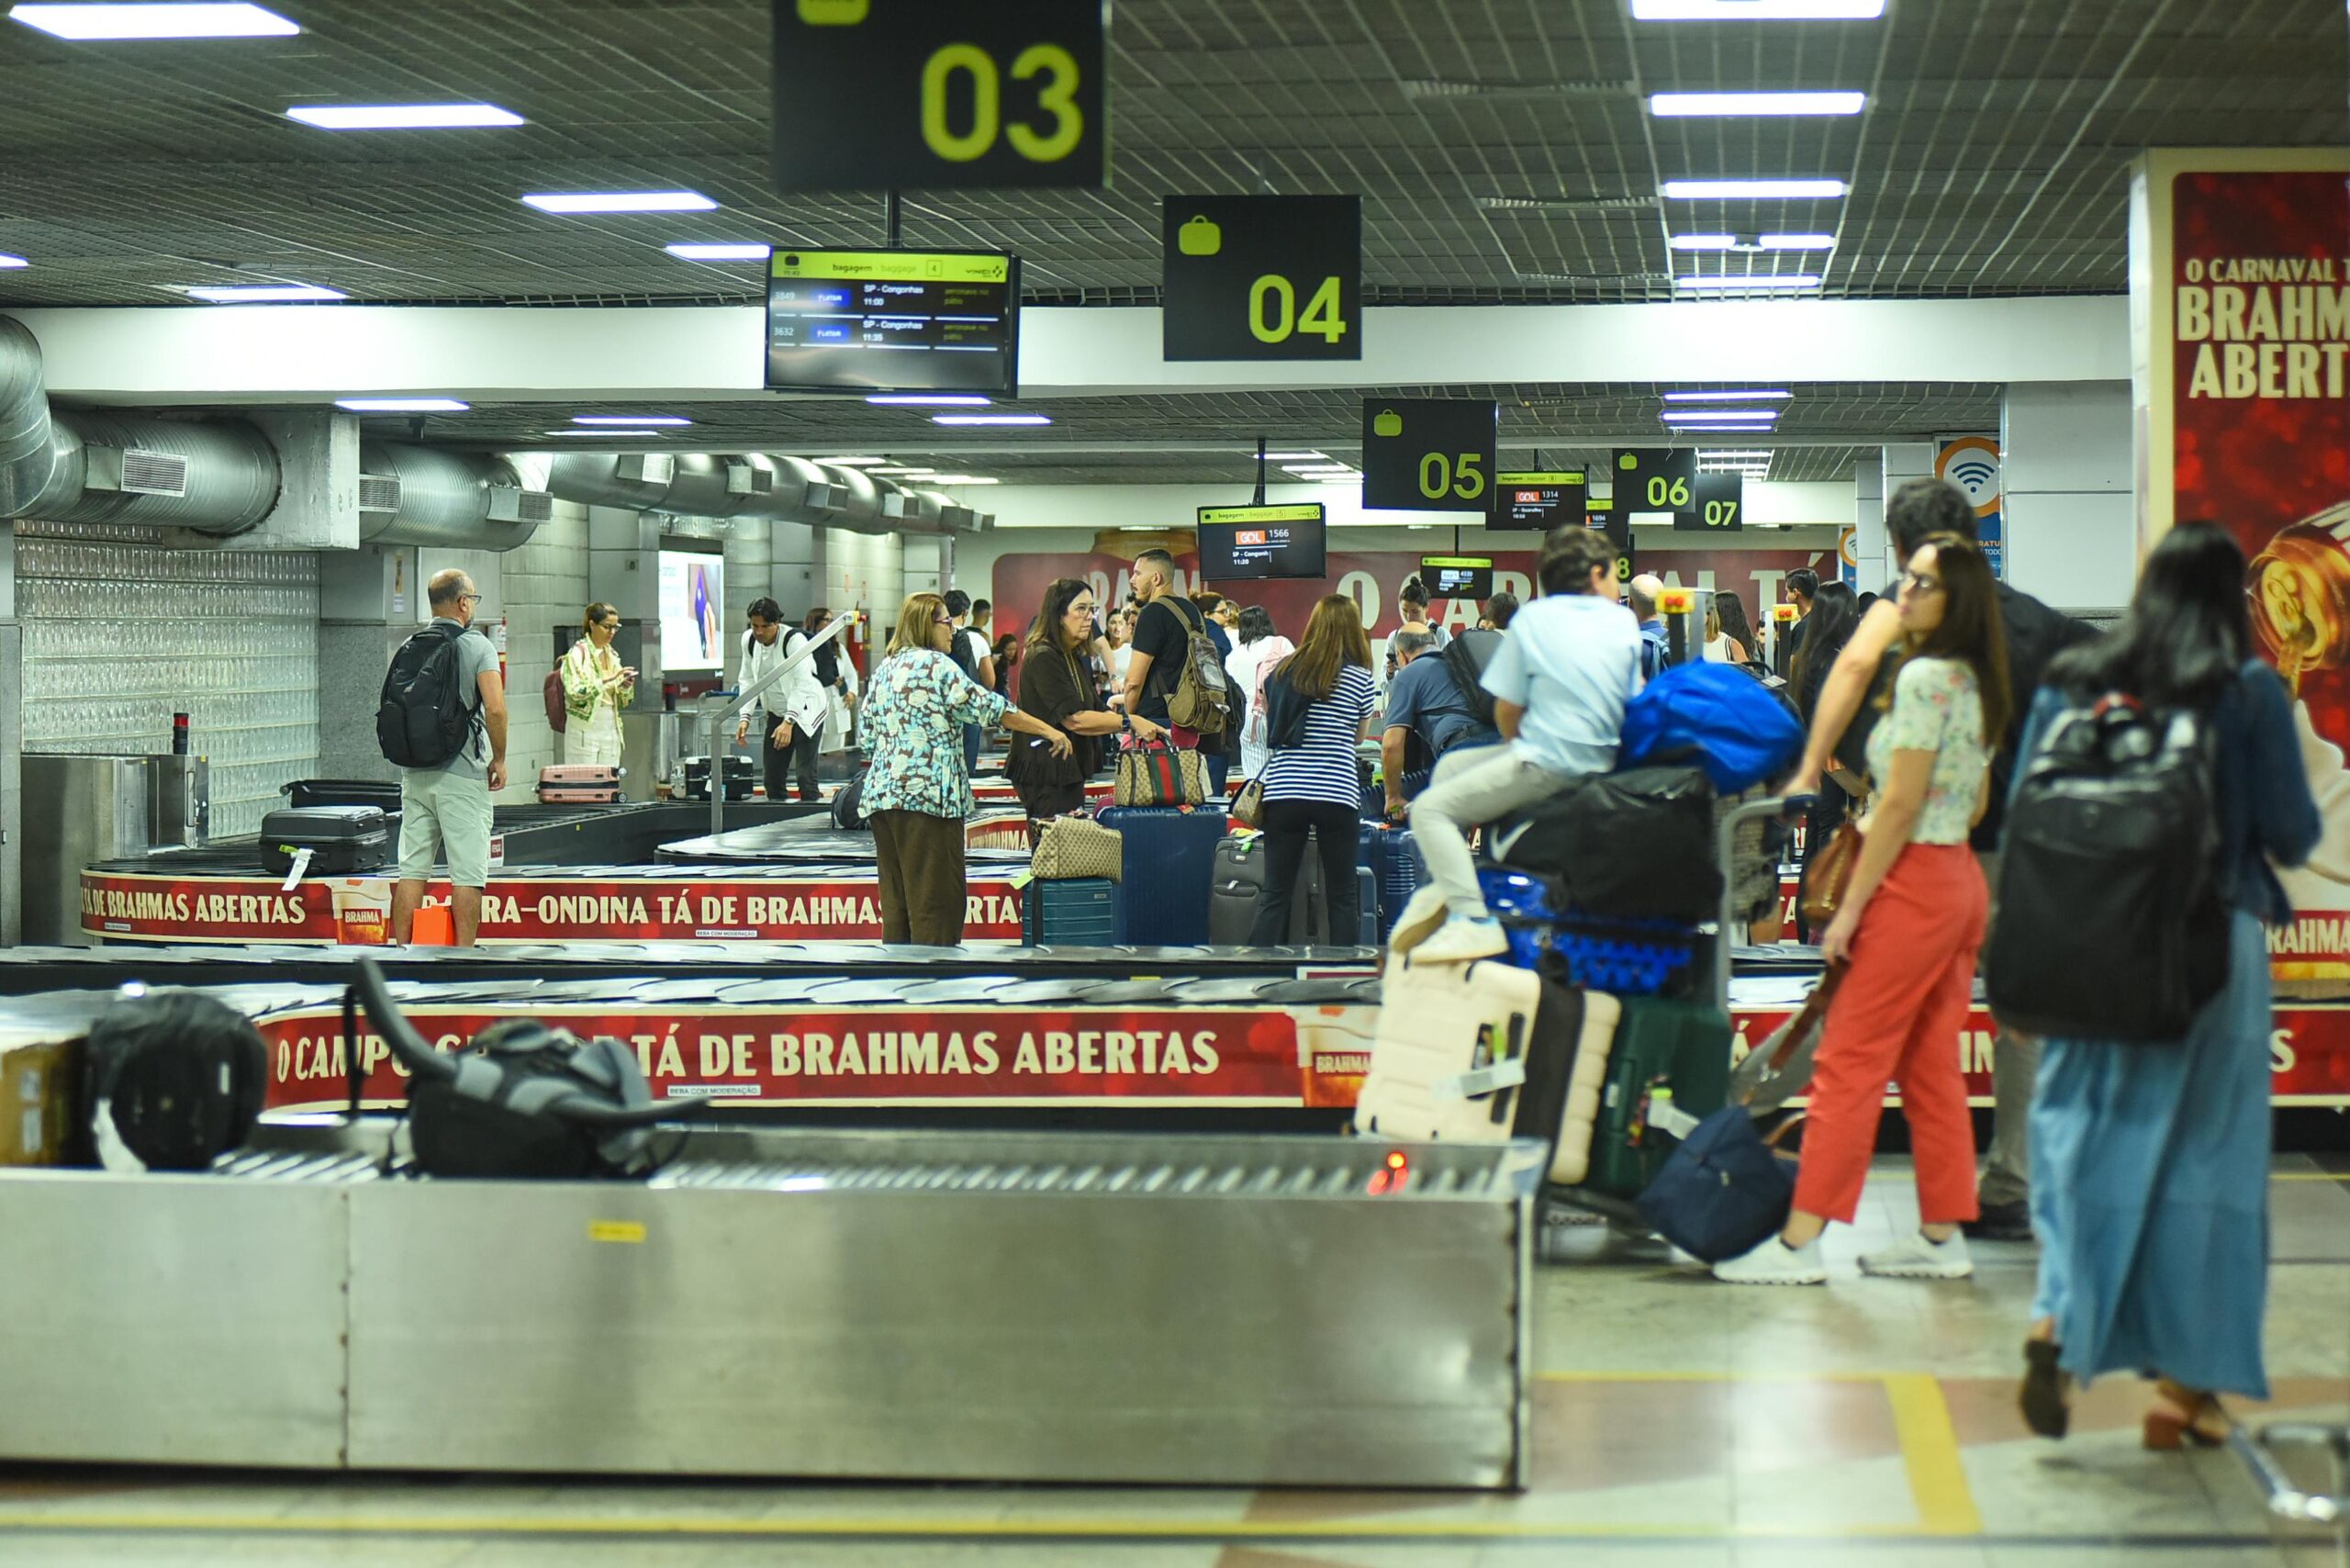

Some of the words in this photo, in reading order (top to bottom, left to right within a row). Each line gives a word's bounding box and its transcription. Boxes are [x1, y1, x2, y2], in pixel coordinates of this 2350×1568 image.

[921, 42, 1083, 162] 03
[2186, 258, 2204, 283] O
[2209, 258, 2335, 283] CARNAVAL
[774, 292, 795, 301] 3849
[864, 285, 876, 293] SP
[881, 285, 924, 295] Congonhas
[1249, 274, 1347, 343] 04
[774, 328, 794, 336] 3632
[863, 320, 875, 329] SP
[880, 320, 923, 330] Congonhas
[2188, 343, 2350, 398] ABERT
[1419, 453, 1484, 498] 05
[1647, 476, 1689, 507] 06
[1705, 500, 1737, 526] 07
[1240, 532, 1261, 543] GOL
[1269, 529, 1290, 538] 1566
[1617, 557, 1630, 579] 8
[93, 889, 106, 917] DE
[107, 890, 190, 922] BRAHMAS
[195, 893, 306, 924] ABERTAS
[344, 911, 380, 924] BRAHMA
[656, 888, 688, 924] TÁ
[700, 896, 738, 924] DE
[747, 895, 883, 925] BRAHMA
[2265, 919, 2350, 955] RAHMA
[277, 1038, 291, 1083] O
[631, 1023, 686, 1077] TÁ
[699, 1034, 757, 1077] DE
[770, 1032, 1000, 1076] BRAHMAS
[1013, 1031, 1220, 1074] ABERTAS
[669, 1087, 689, 1095] BEBA
[690, 1087, 708, 1095] COM
